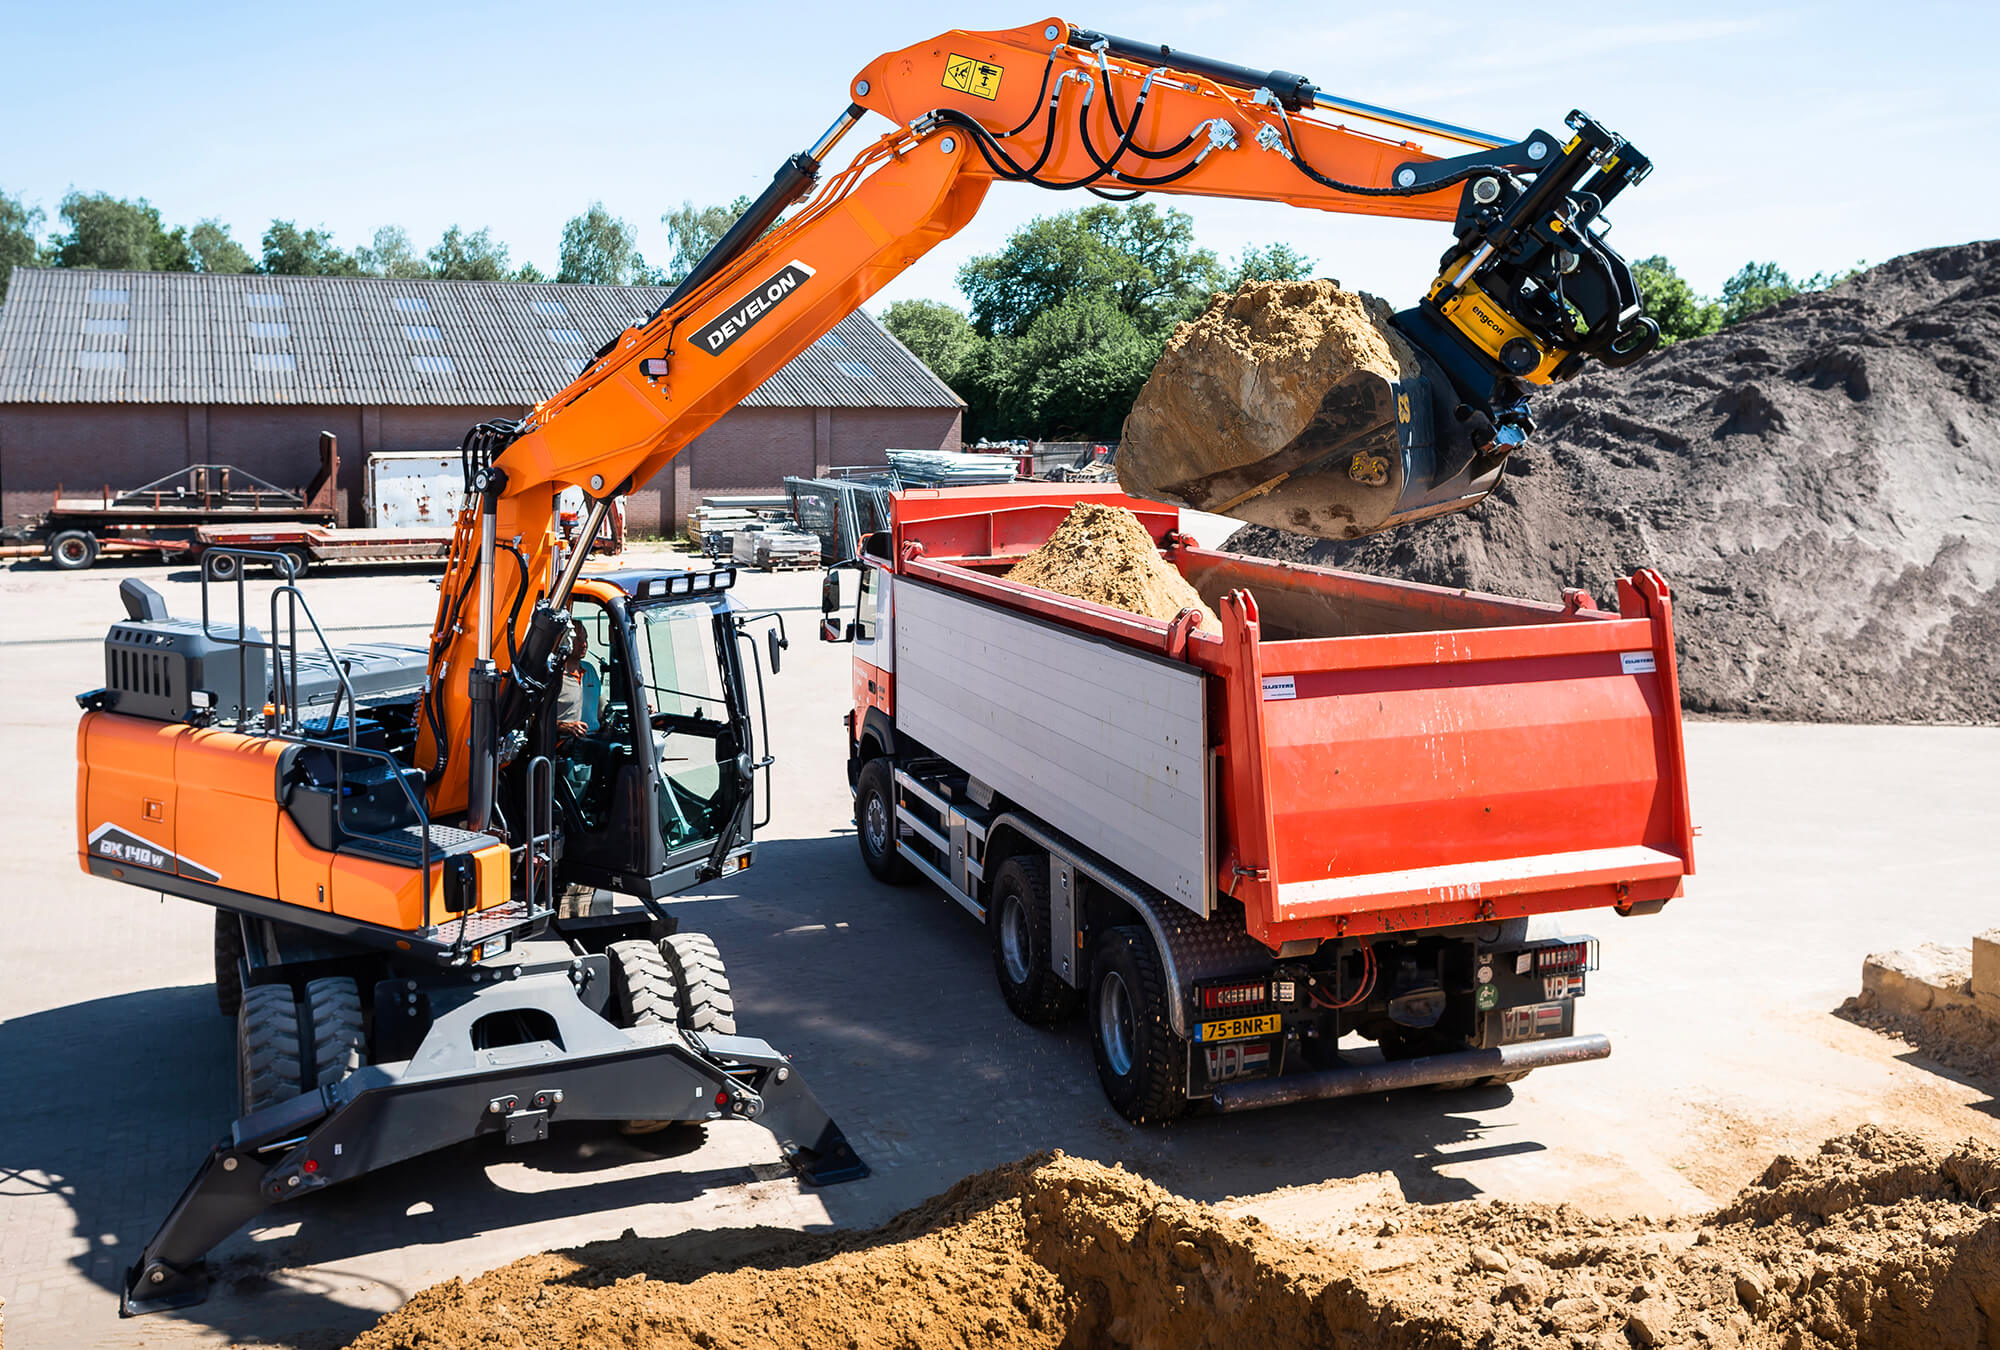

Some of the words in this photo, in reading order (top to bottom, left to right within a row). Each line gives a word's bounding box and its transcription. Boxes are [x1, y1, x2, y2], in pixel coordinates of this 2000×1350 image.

[706, 272, 797, 350] DEVELON
[1472, 305, 1505, 336] engcon
[1543, 975, 1574, 1000] VDL
[1208, 1016, 1275, 1039] 75-BNR-1
[1204, 1042, 1252, 1082] VDL
